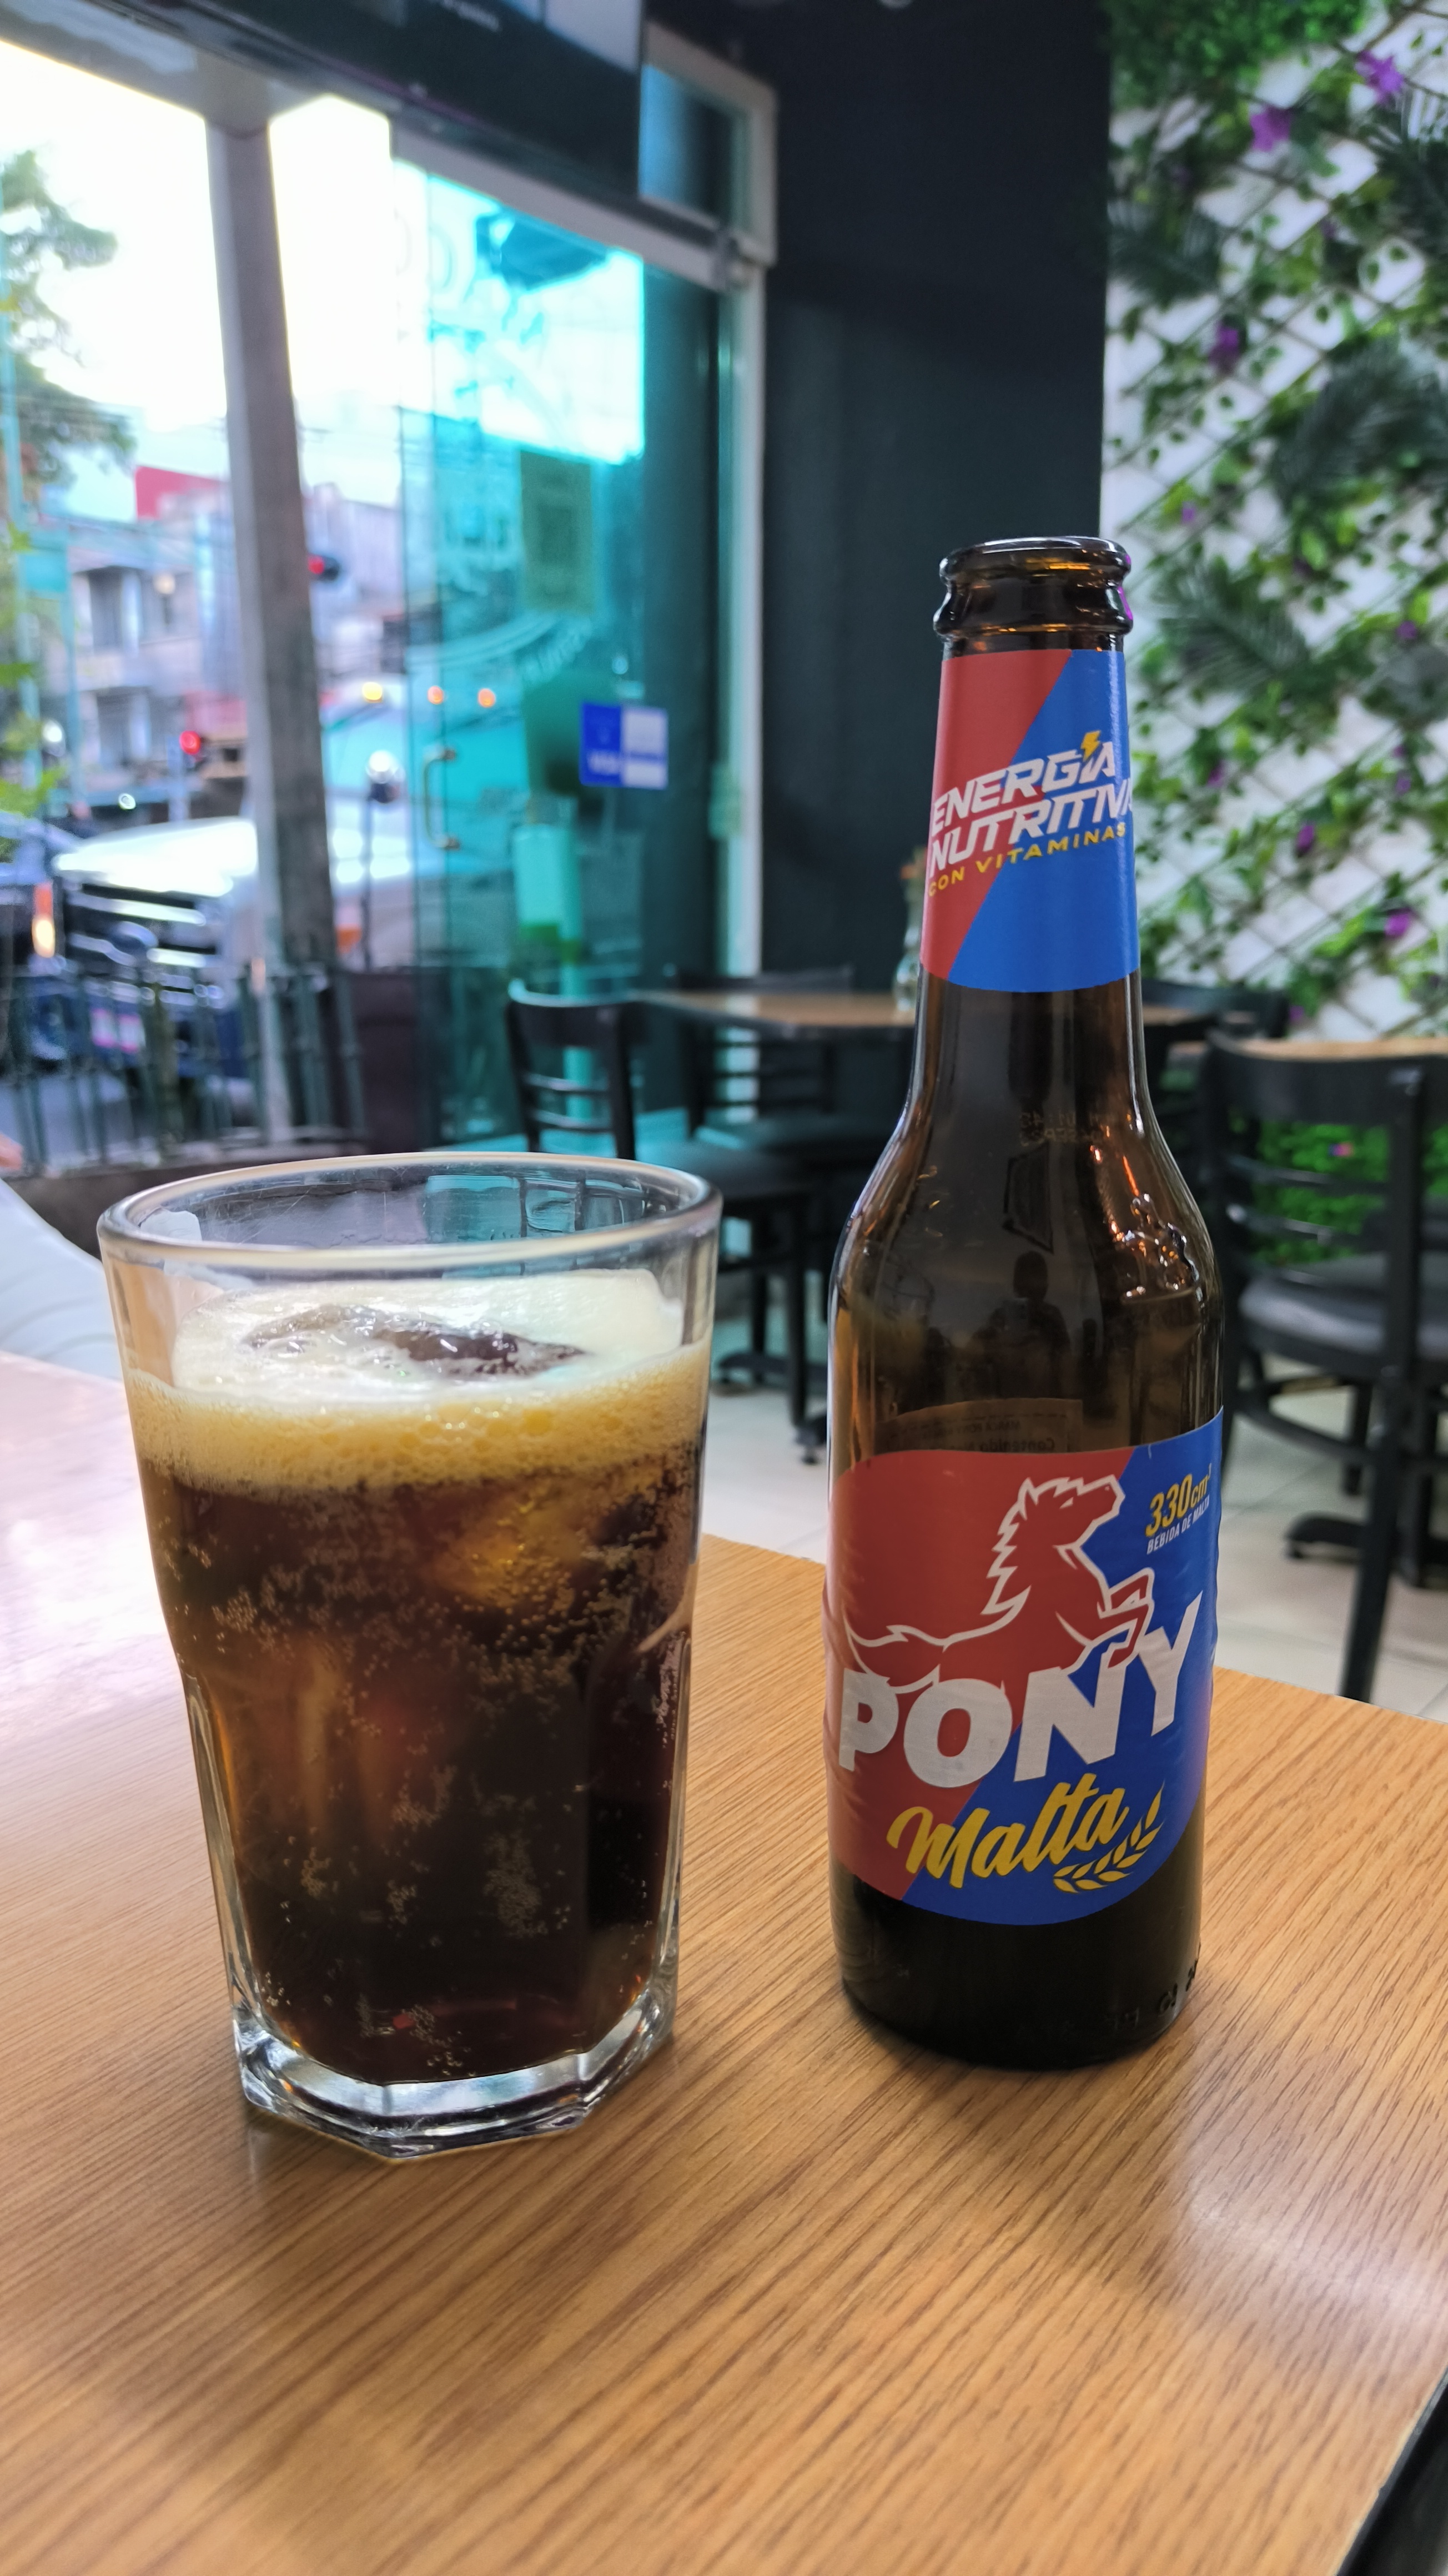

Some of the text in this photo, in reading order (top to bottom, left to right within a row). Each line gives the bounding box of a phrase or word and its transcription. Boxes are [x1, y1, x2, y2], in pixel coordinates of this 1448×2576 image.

[928, 822, 1126, 897] CON VITAMINAS
[1147, 1522, 1180, 1555] BEBIDA
[1181, 1512, 1192, 1533] DE
[839, 1591, 1203, 1788] PONY
[887, 1773, 1130, 1889] Malta
